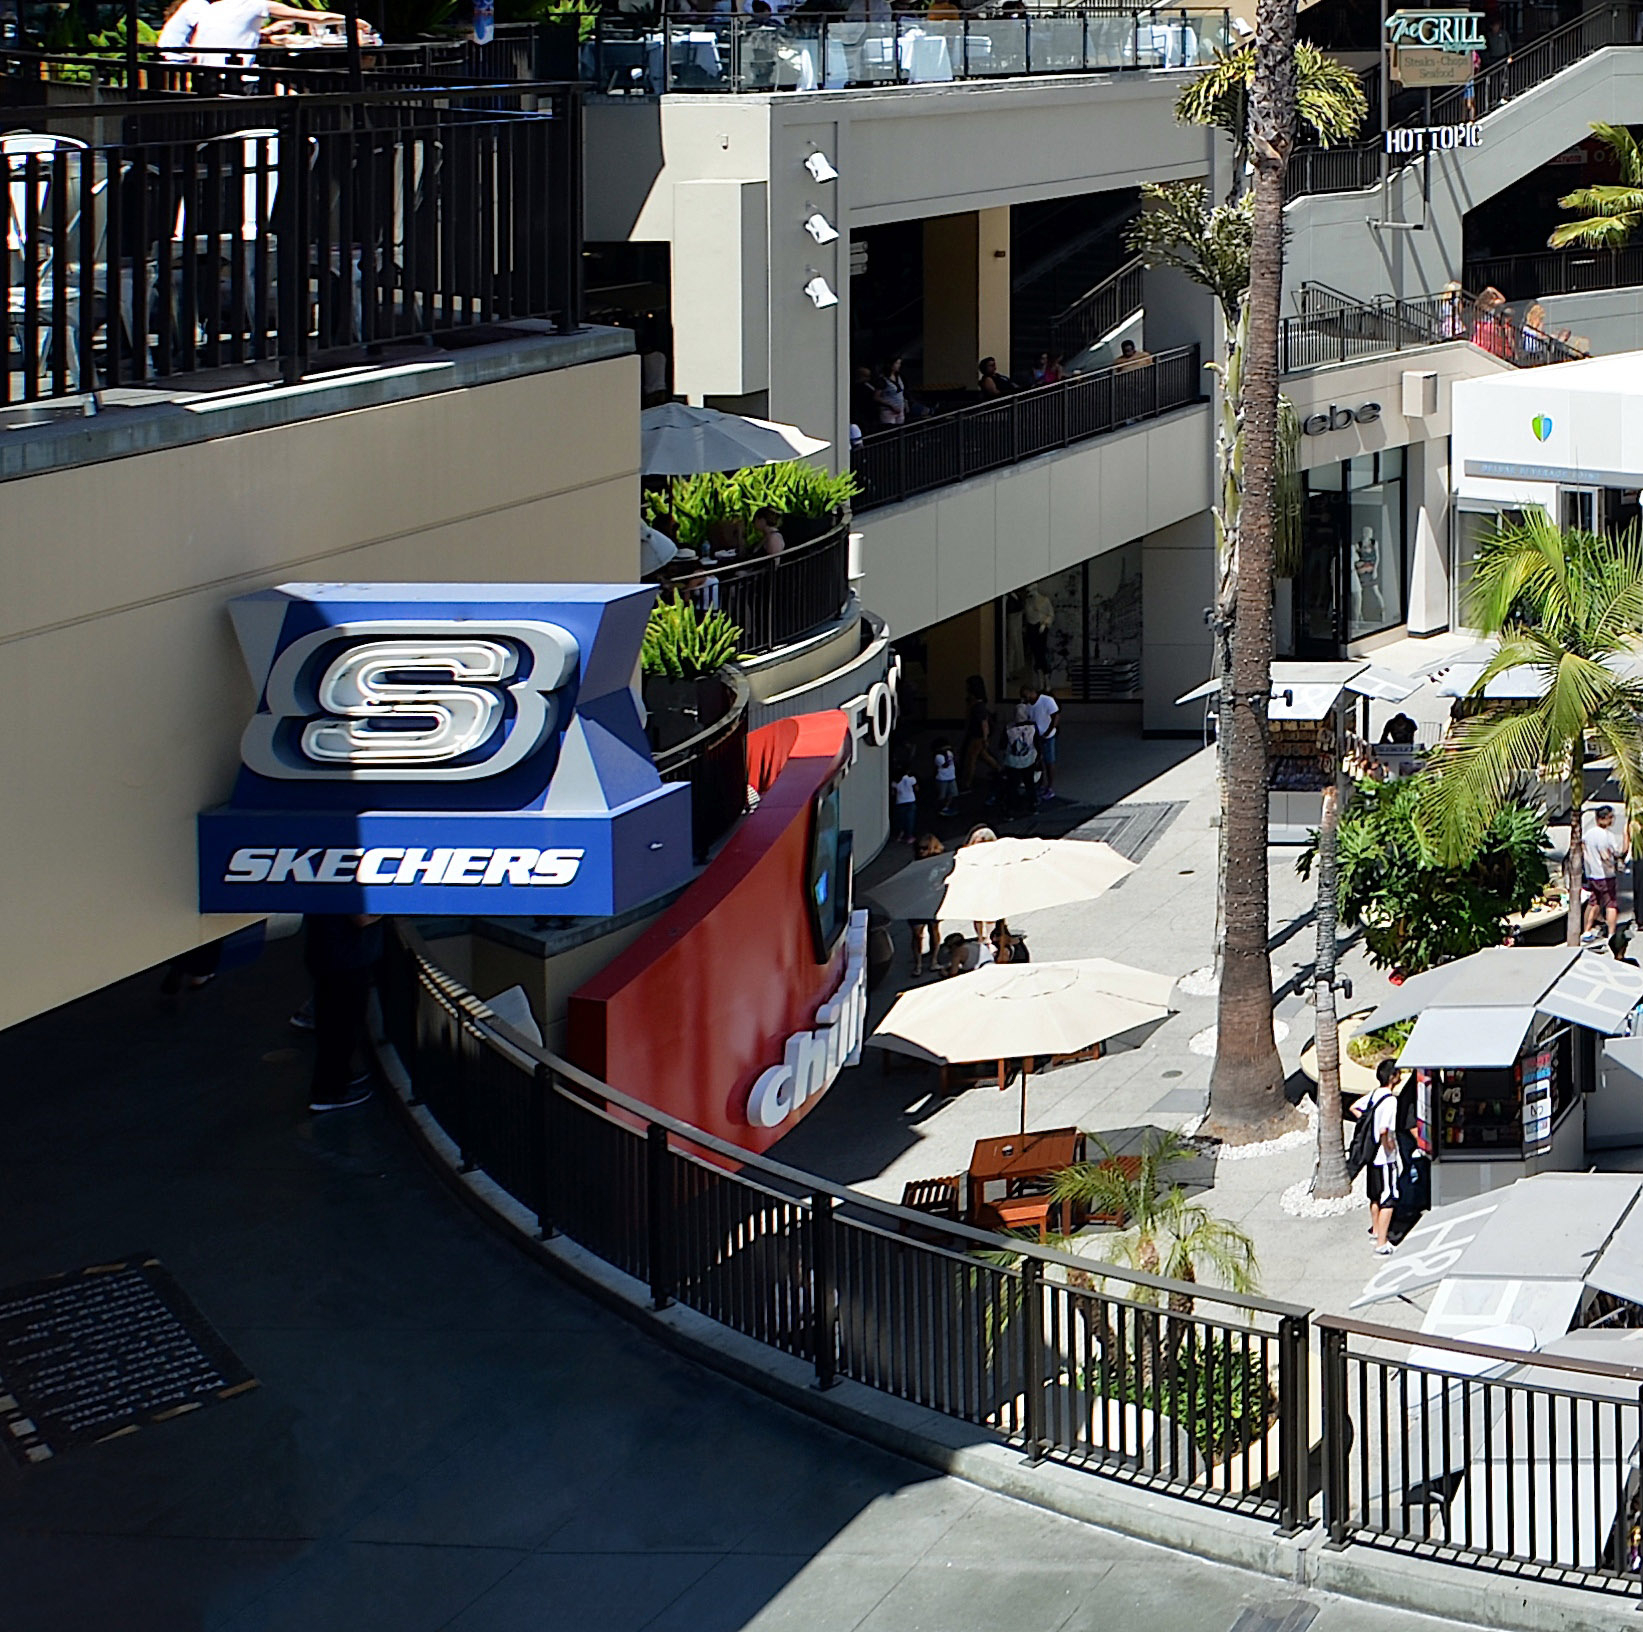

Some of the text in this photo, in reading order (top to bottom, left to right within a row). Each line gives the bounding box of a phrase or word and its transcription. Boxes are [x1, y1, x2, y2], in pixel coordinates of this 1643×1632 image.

[1385, 15, 1485, 45] The GRILL
[1404, 56, 1436, 68] Steaks
[1419, 68, 1454, 79] Seafood
[1386, 124, 1484, 153] HOT TOPIC
[1301, 402, 1381, 436] ebe
[223, 847, 587, 888] SKECHERS
